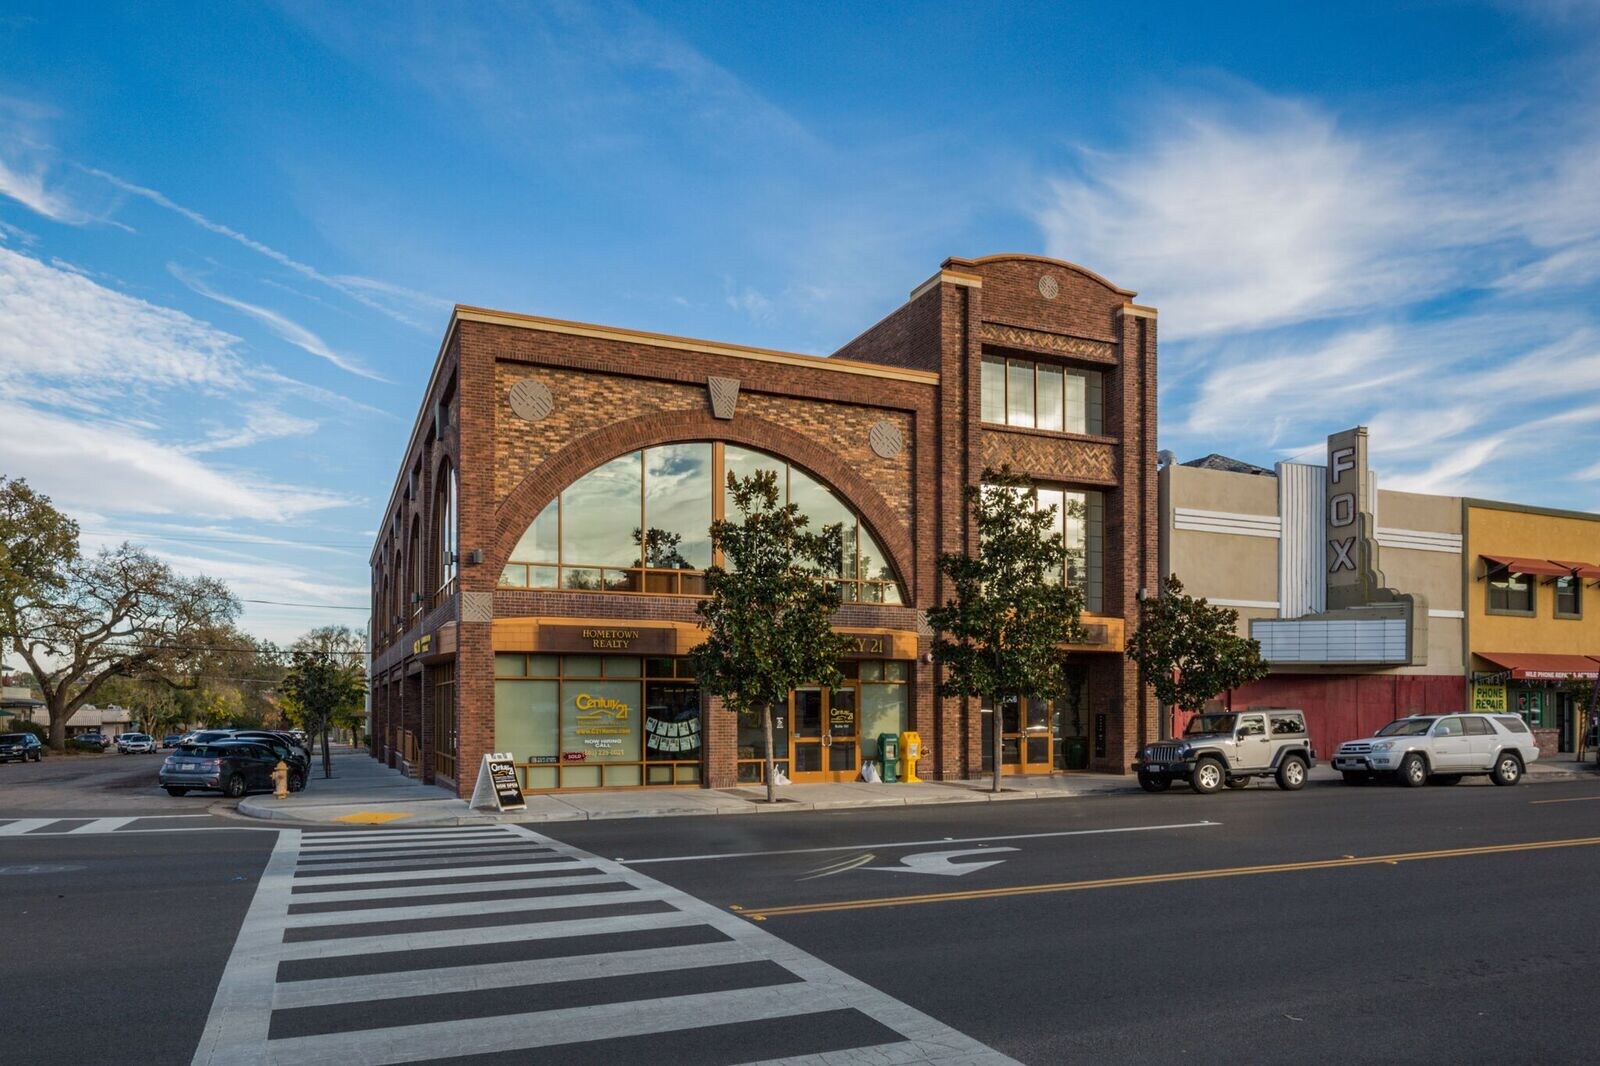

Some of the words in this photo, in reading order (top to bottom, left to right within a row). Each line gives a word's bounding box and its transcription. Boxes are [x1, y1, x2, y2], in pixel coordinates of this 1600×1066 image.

[1329, 446, 1357, 573] FOX
[583, 629, 639, 639] HOMETOWN
[593, 640, 630, 648] REALTY
[870, 638, 883, 653] 21
[1476, 688, 1503, 698] PHONE
[576, 693, 619, 710] Century
[616, 704, 629, 719] 21
[1475, 699, 1504, 709] REPAIR
